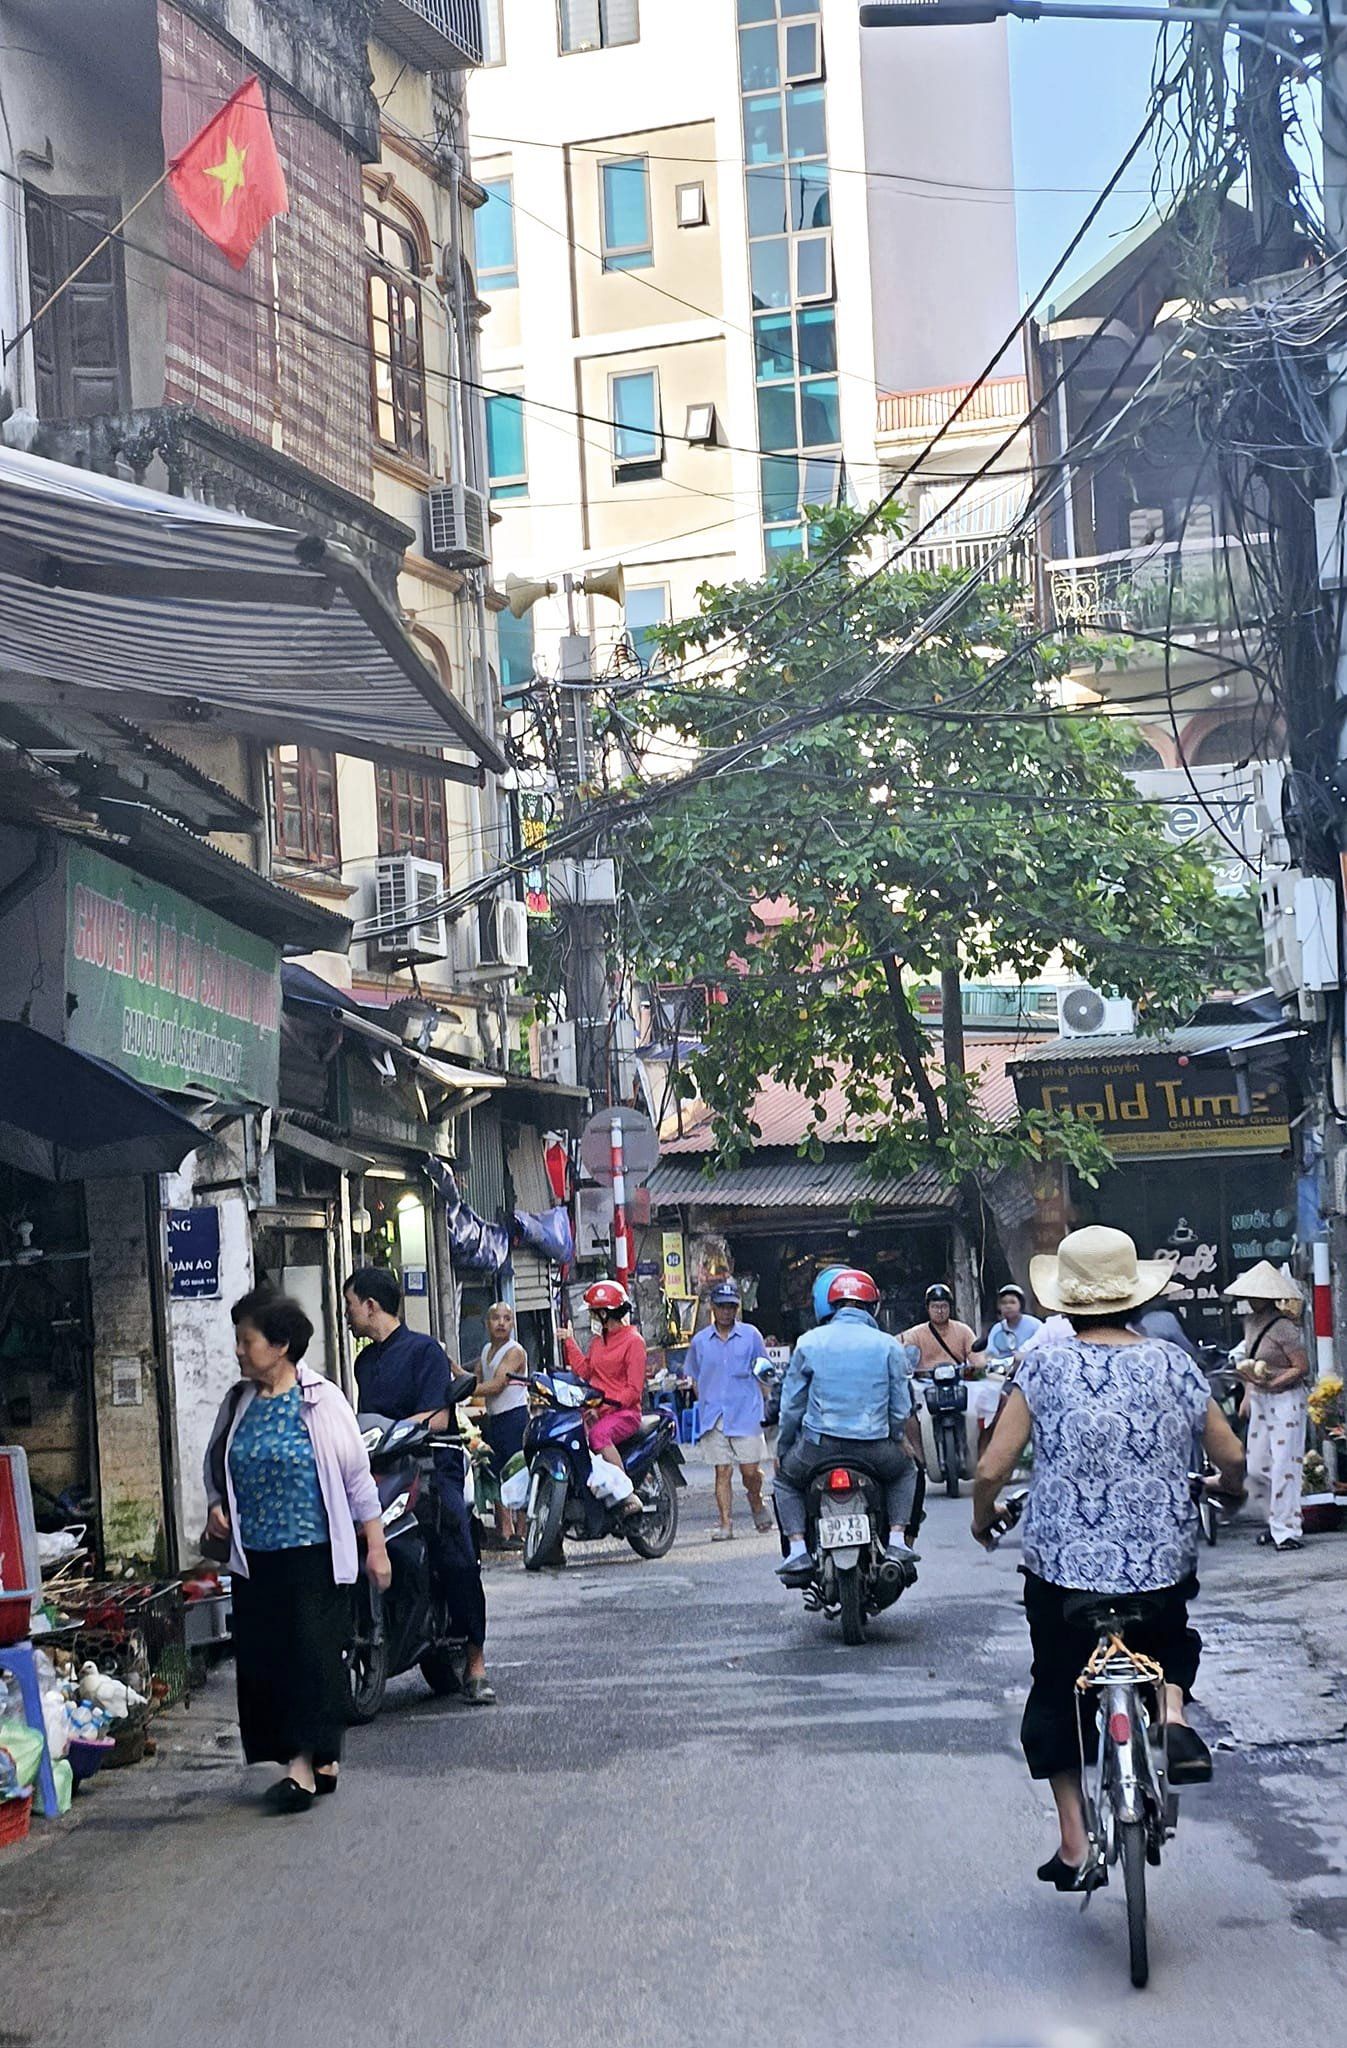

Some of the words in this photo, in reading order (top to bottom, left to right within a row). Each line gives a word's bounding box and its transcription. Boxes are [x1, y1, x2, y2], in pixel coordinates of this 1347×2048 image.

[122, 1006, 145, 1055] RAU
[1168, 1118, 1212, 1130] Golden
[1215, 1116, 1246, 1126] Time
